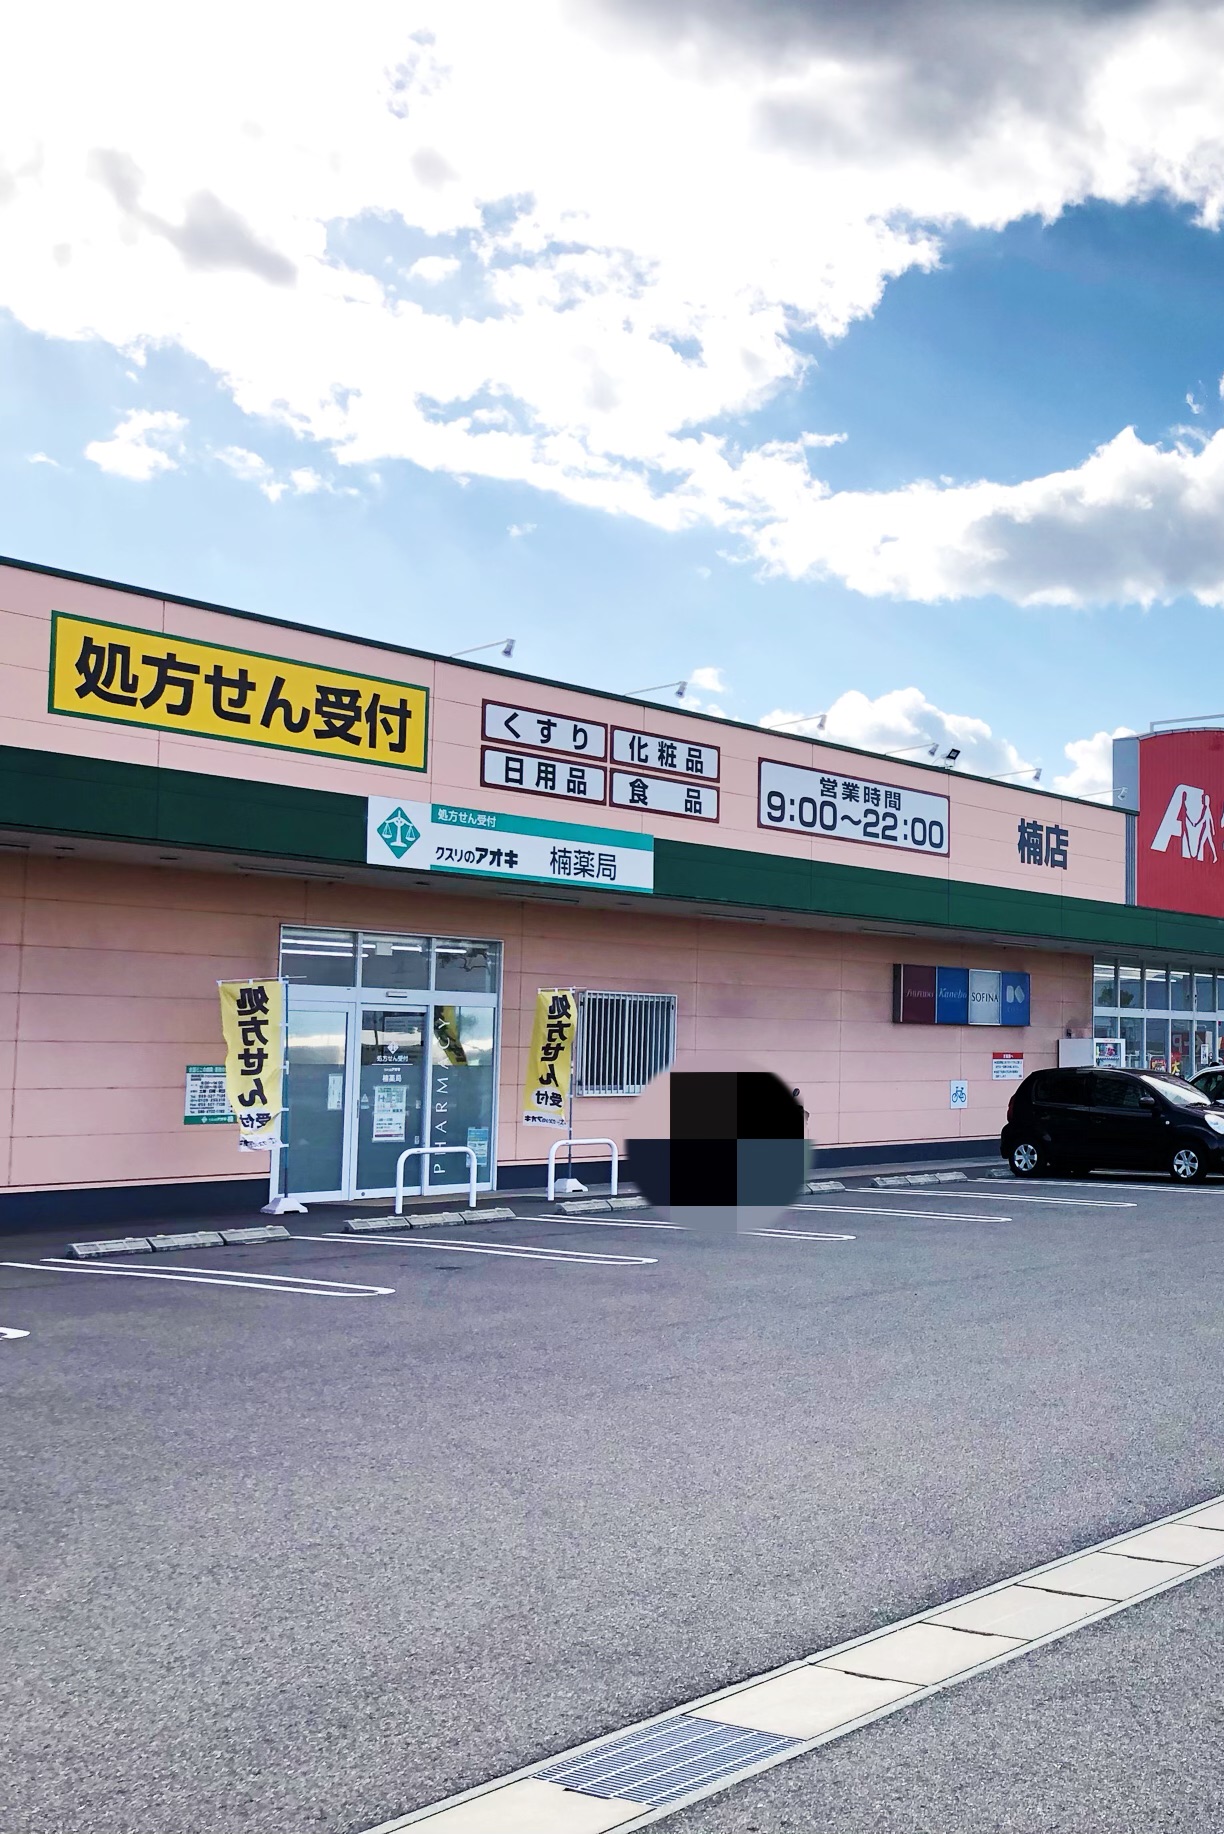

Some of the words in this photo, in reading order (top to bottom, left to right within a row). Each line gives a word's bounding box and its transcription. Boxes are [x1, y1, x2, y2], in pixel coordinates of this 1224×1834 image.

[75, 636, 412, 753] 処方せん受付
[503, 711, 589, 751] くすり
[628, 734, 704, 775] 化粧品
[504, 756, 588, 796] 日用品
[819, 777, 901, 811] 営業時間
[437, 808, 497, 828] 処方せん受付
[435, 846, 519, 869] クスリのアオキ
[550, 846, 617, 881] 楠薬局
[1017, 817, 1069, 870] 楠店
[971, 992, 999, 1003] SOFINA
